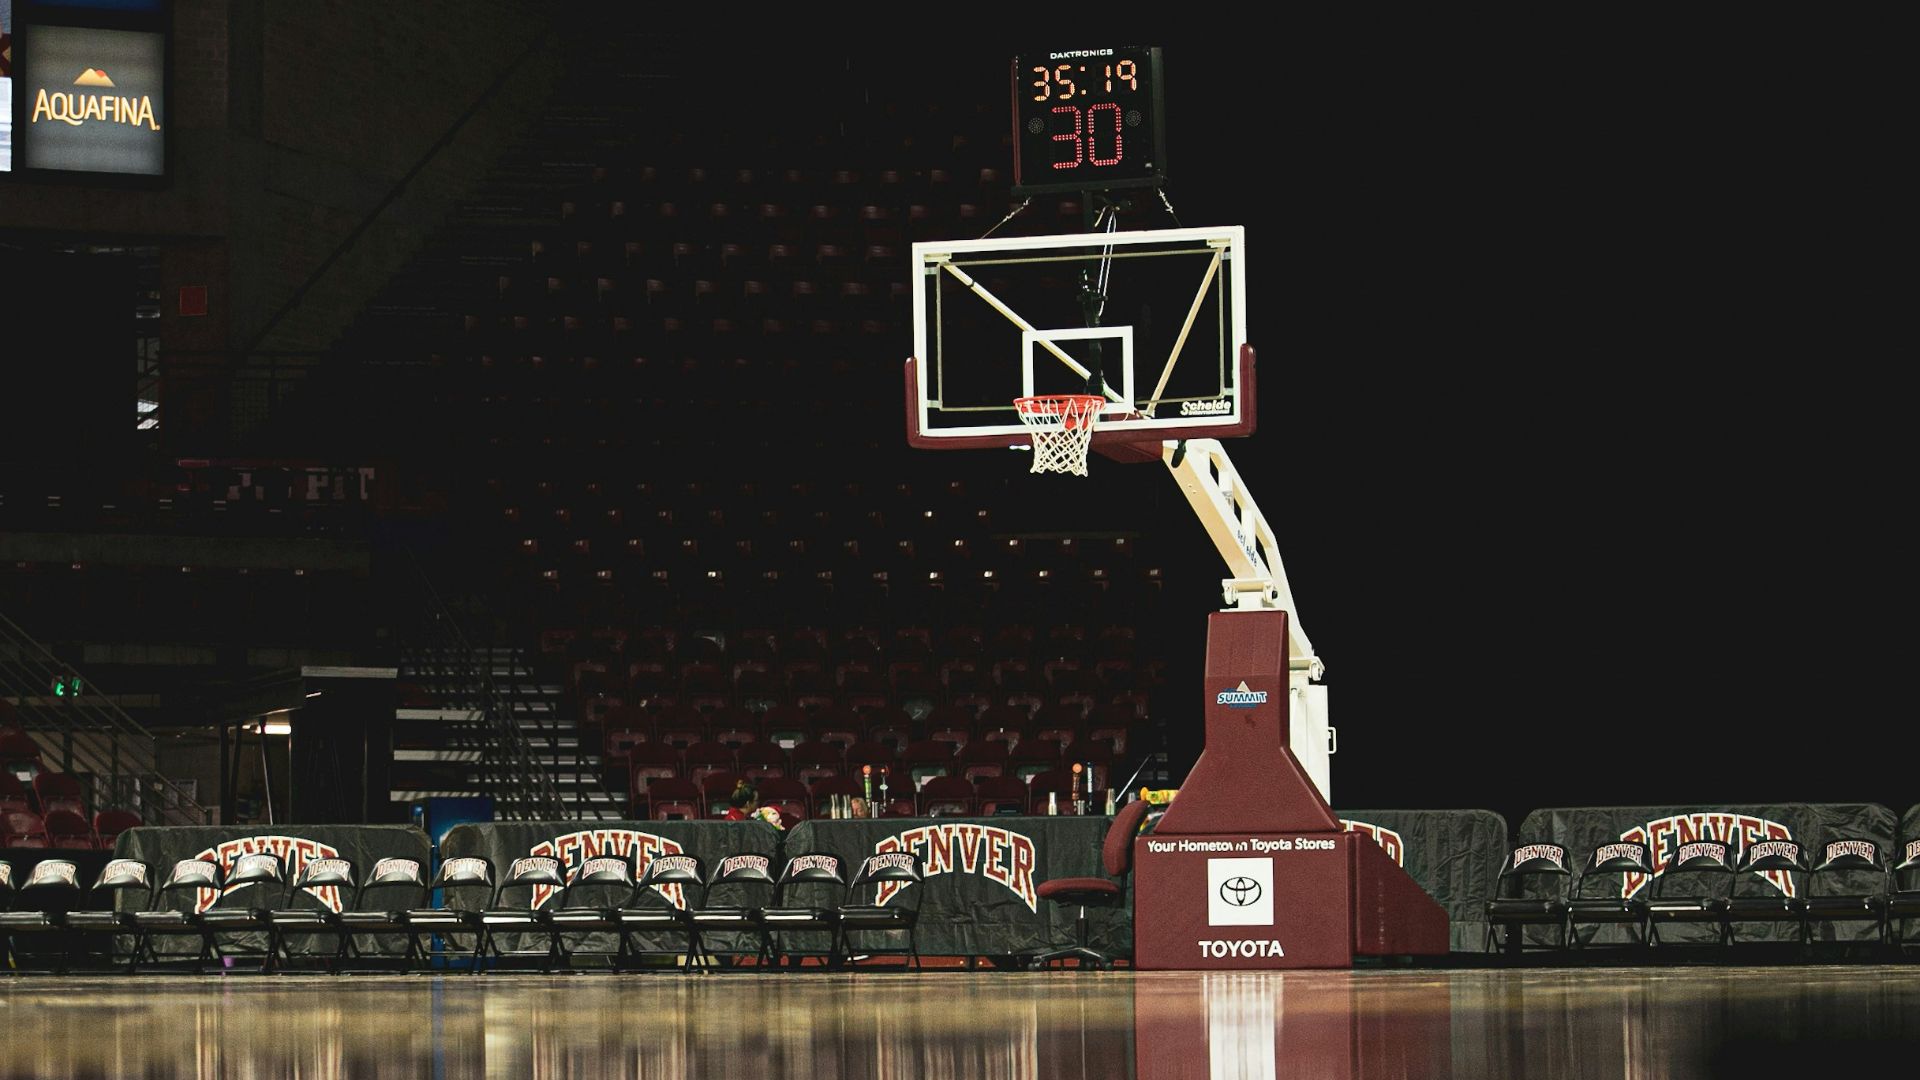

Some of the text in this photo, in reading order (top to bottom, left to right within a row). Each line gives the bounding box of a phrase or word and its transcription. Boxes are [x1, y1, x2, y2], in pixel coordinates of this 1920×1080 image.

[1050, 49, 1113, 59] DAKTRONICS
[1033, 60, 1137, 101] 35:19
[32, 88, 158, 130] AQUAFINA
[1052, 103, 1122, 169] 30
[1180, 400, 1231, 415] Schelde
[1217, 691, 1267, 704] SUMMIT
[1148, 840, 1176, 853] Your
[1250, 839, 1291, 853] Toyota
[1295, 838, 1335, 850] Stores
[1514, 844, 1564, 869] DENVER
[1596, 844, 1643, 867] DENVER
[1678, 842, 1725, 866] DENVER
[1750, 841, 1798, 866] DENVER
[1826, 840, 1875, 865] DENVER
[514, 858, 557, 880] DENVER
[652, 857, 697, 879] DENVER
[723, 855, 769, 877] DENVER
[792, 855, 838, 877] DENVER
[868, 853, 915, 876] DENVER
[875, 824, 1036, 914] DENVER
[1198, 940, 1285, 958] TOYOTA
